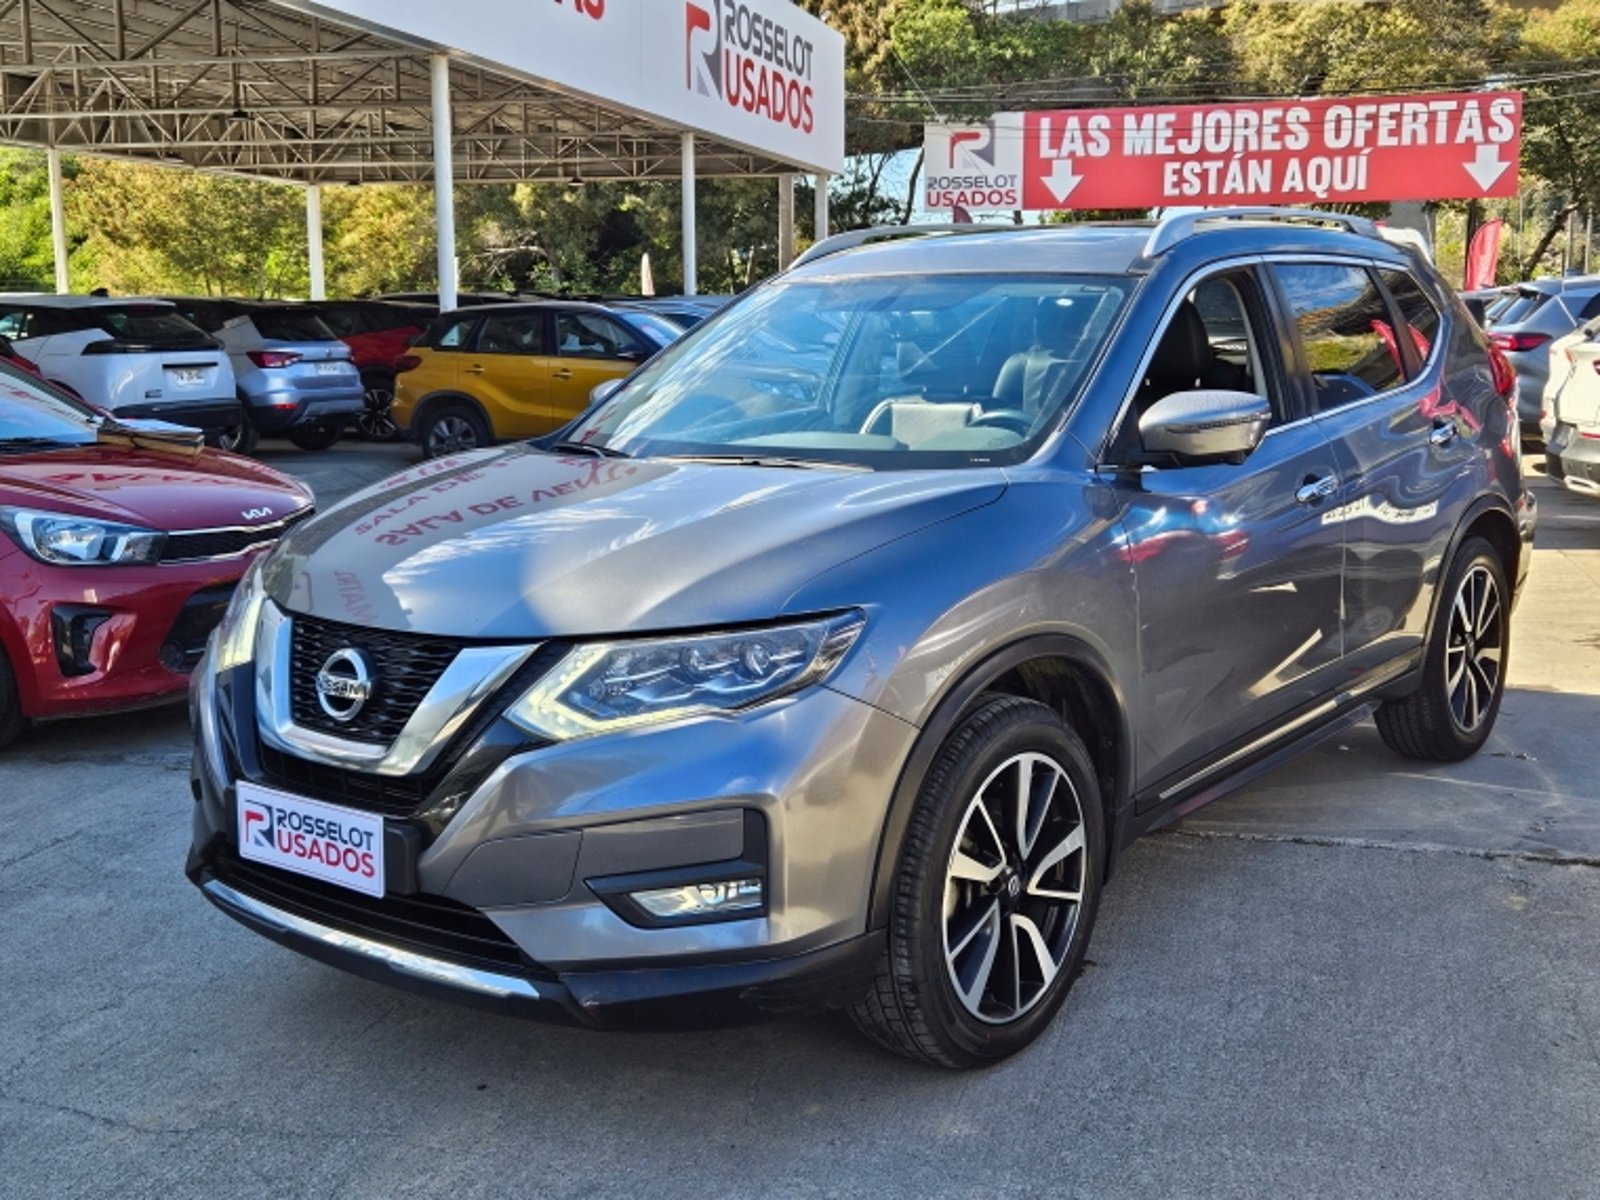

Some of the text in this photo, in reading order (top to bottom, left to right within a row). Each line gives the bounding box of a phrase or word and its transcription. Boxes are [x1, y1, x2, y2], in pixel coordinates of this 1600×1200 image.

[725, 1, 813, 80] ROSSELOT
[725, 48, 813, 134] USADOS
[1039, 98, 1516, 159] LAS MEJORES OFERTAS
[927, 174, 1018, 190] ROSSELOT
[1163, 147, 1374, 198] ESTÁN AQUÍ
[927, 189, 1018, 207] USADOS
[276, 808, 373, 851] ROSSELOT
[277, 829, 376, 878] USADOS
